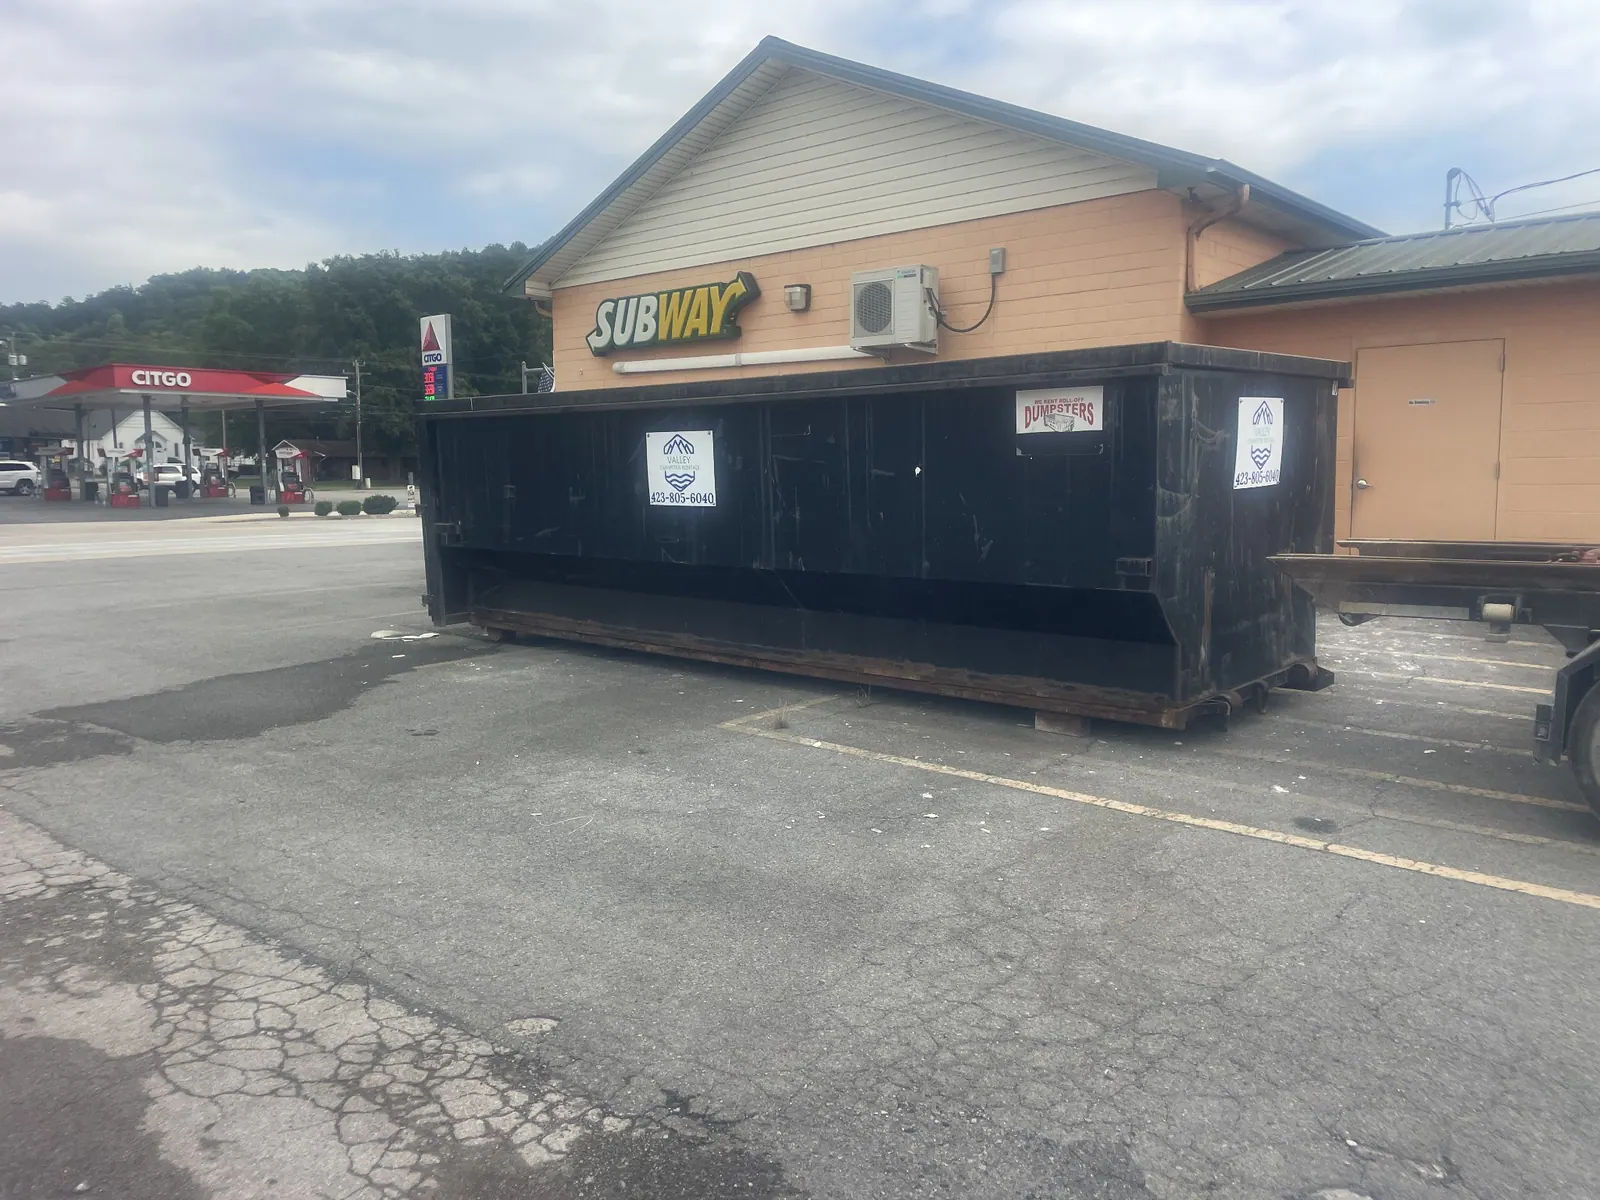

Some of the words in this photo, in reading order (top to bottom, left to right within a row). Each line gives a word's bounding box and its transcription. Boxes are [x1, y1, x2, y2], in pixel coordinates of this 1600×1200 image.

[587, 278, 747, 351] SUBWAY
[424, 353, 442, 363] CITGO
[131, 369, 192, 387] CITGO
[1024, 402, 1095, 429] DUMPSTERS
[667, 456, 691, 464] VALLEY
[1235, 469, 1280, 486] 423-805-6040
[651, 491, 715, 504] 423-805-6040
